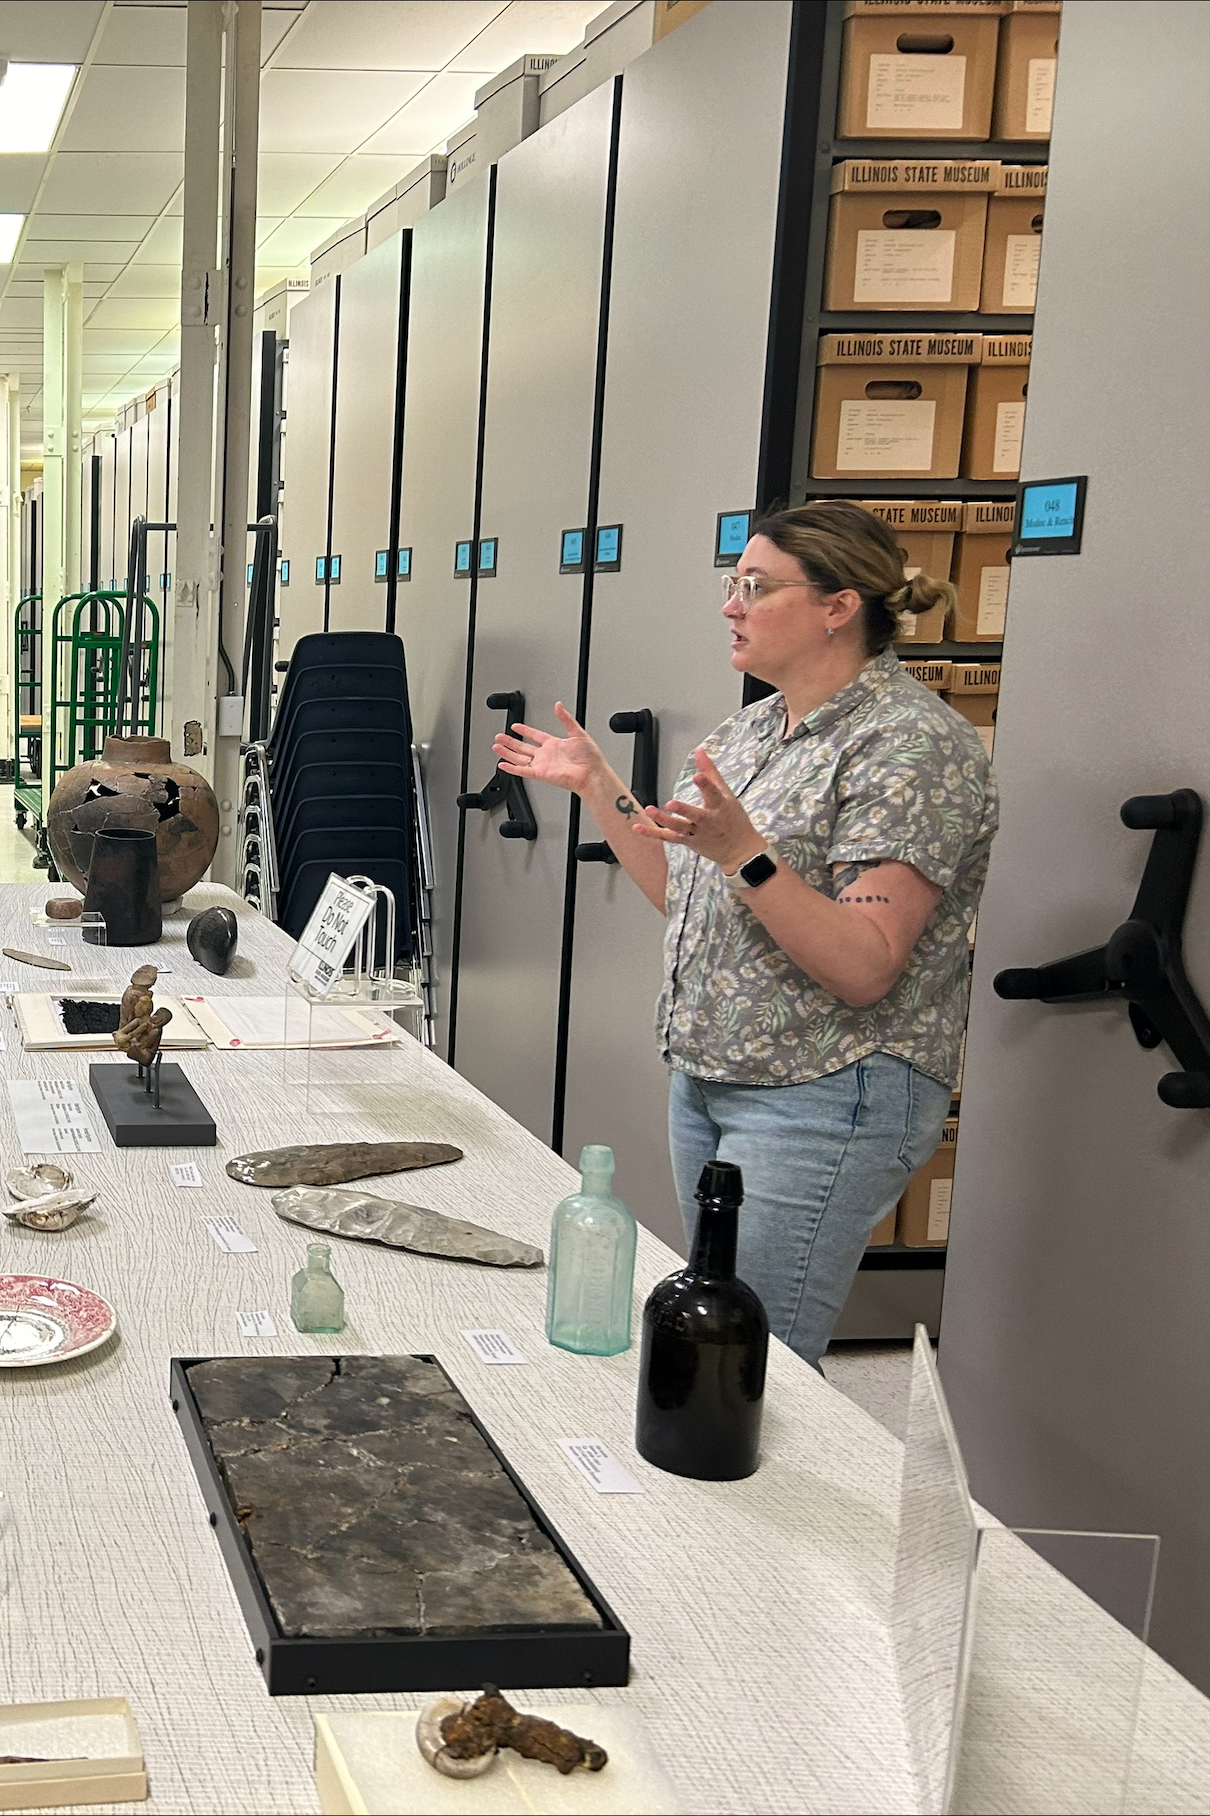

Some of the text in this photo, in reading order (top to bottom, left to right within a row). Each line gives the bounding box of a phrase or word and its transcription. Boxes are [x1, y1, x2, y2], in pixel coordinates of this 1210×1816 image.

[851, 166, 990, 183] ILLINOIS STATE MUSEUM
[836, 339, 974, 357] ILLINOIS STATE MUSEUM
[1044, 499, 1061, 512] 048
[911, 507, 957, 523] MUSEUM
[333, 891, 354, 914] Please
[322, 906, 349, 935] Do Not
[314, 925, 337, 953] Touch
